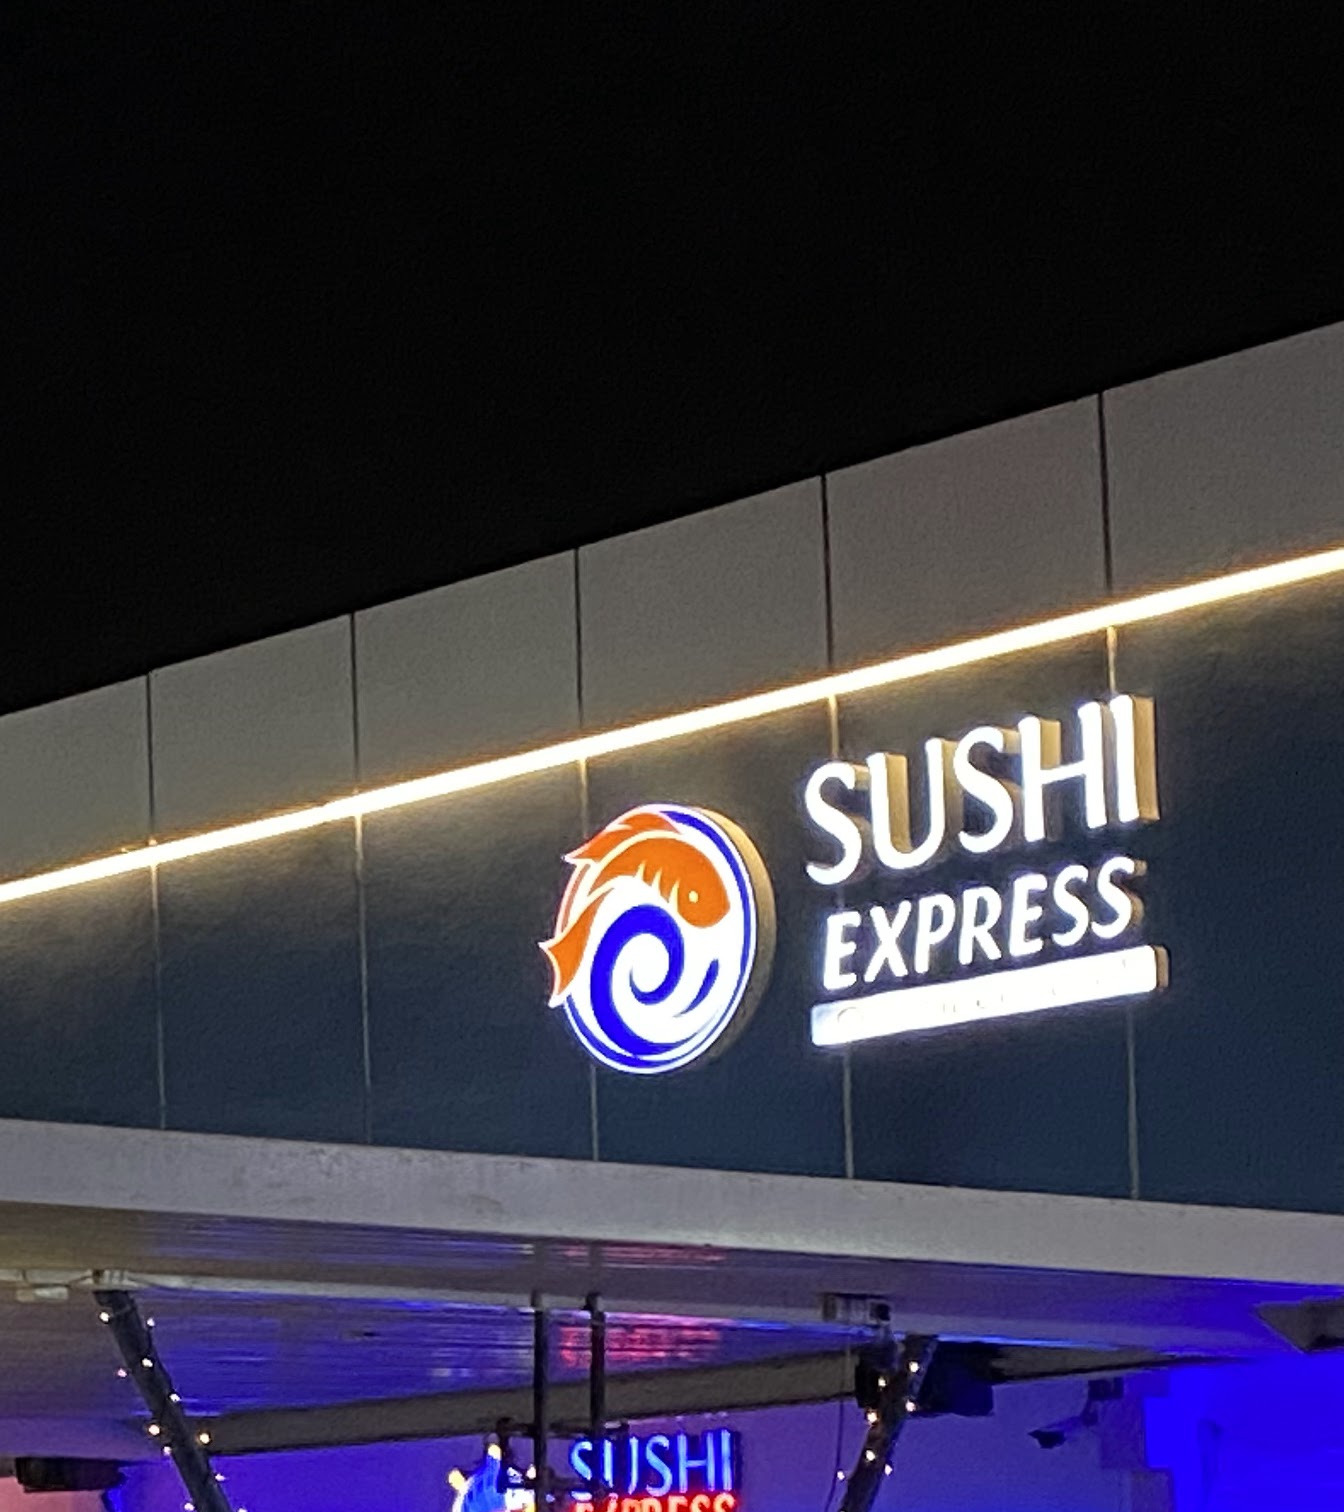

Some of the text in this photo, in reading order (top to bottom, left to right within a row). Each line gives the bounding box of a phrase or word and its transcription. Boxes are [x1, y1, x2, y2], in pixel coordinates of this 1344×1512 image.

[804, 694, 1144, 887] SUSHI
[822, 857, 1137, 991] EXPRESS
[569, 1428, 735, 1500] SUSHI
